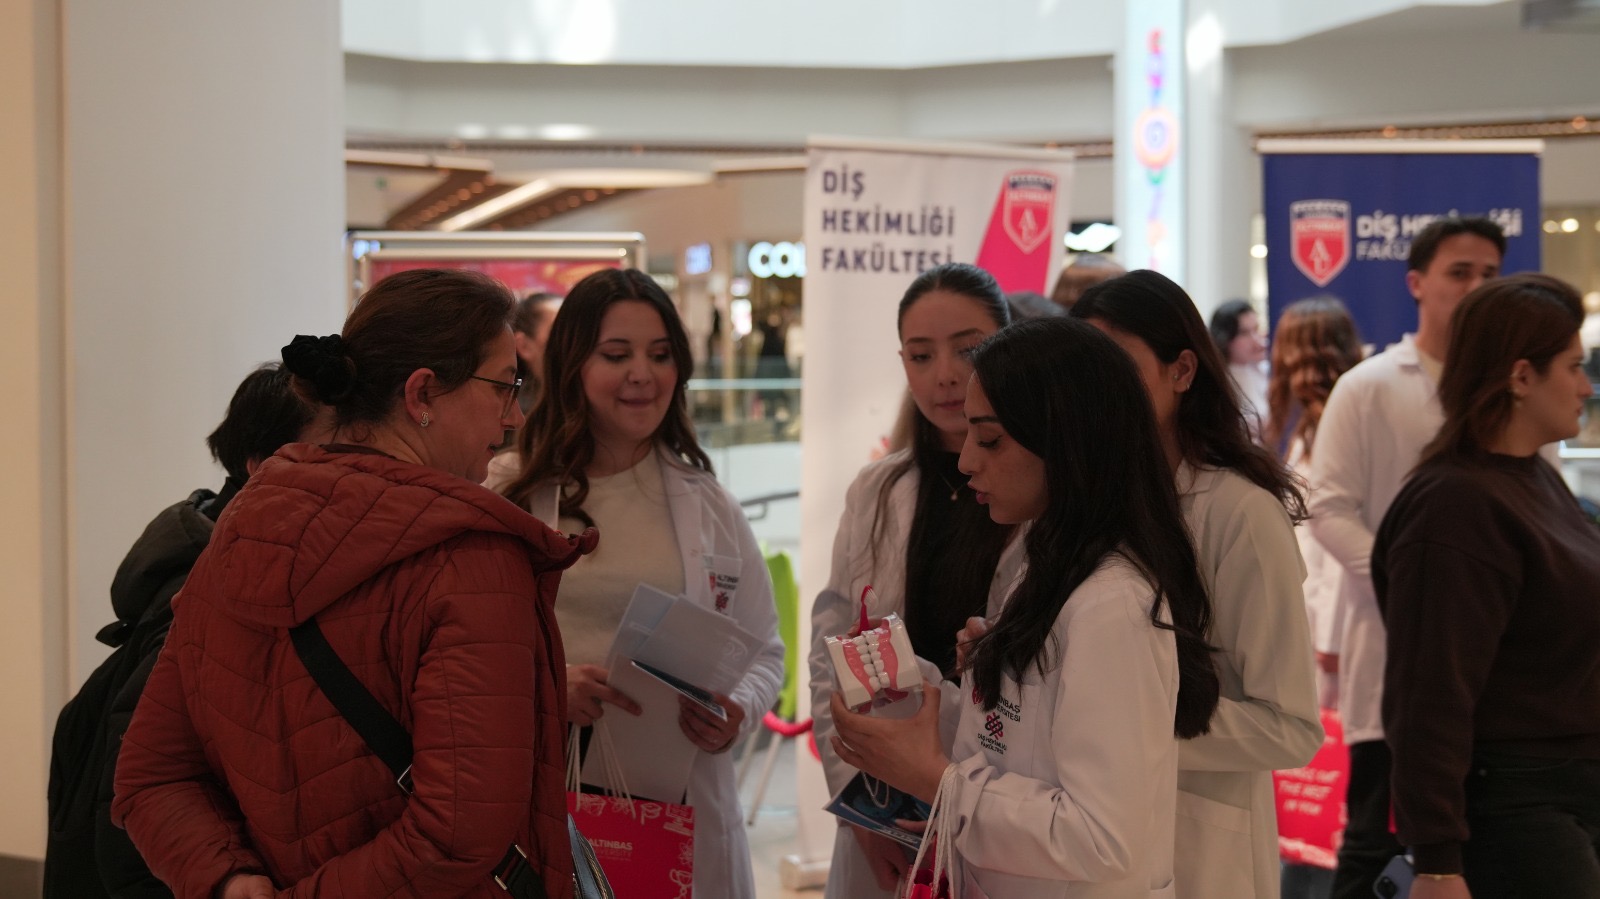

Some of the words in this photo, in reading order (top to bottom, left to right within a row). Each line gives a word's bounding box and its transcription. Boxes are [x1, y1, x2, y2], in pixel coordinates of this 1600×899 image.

[822, 163, 866, 201] DİŞ
[822, 204, 956, 237] HEKİMLİĞİ
[1355, 210, 1400, 241] DİŞ
